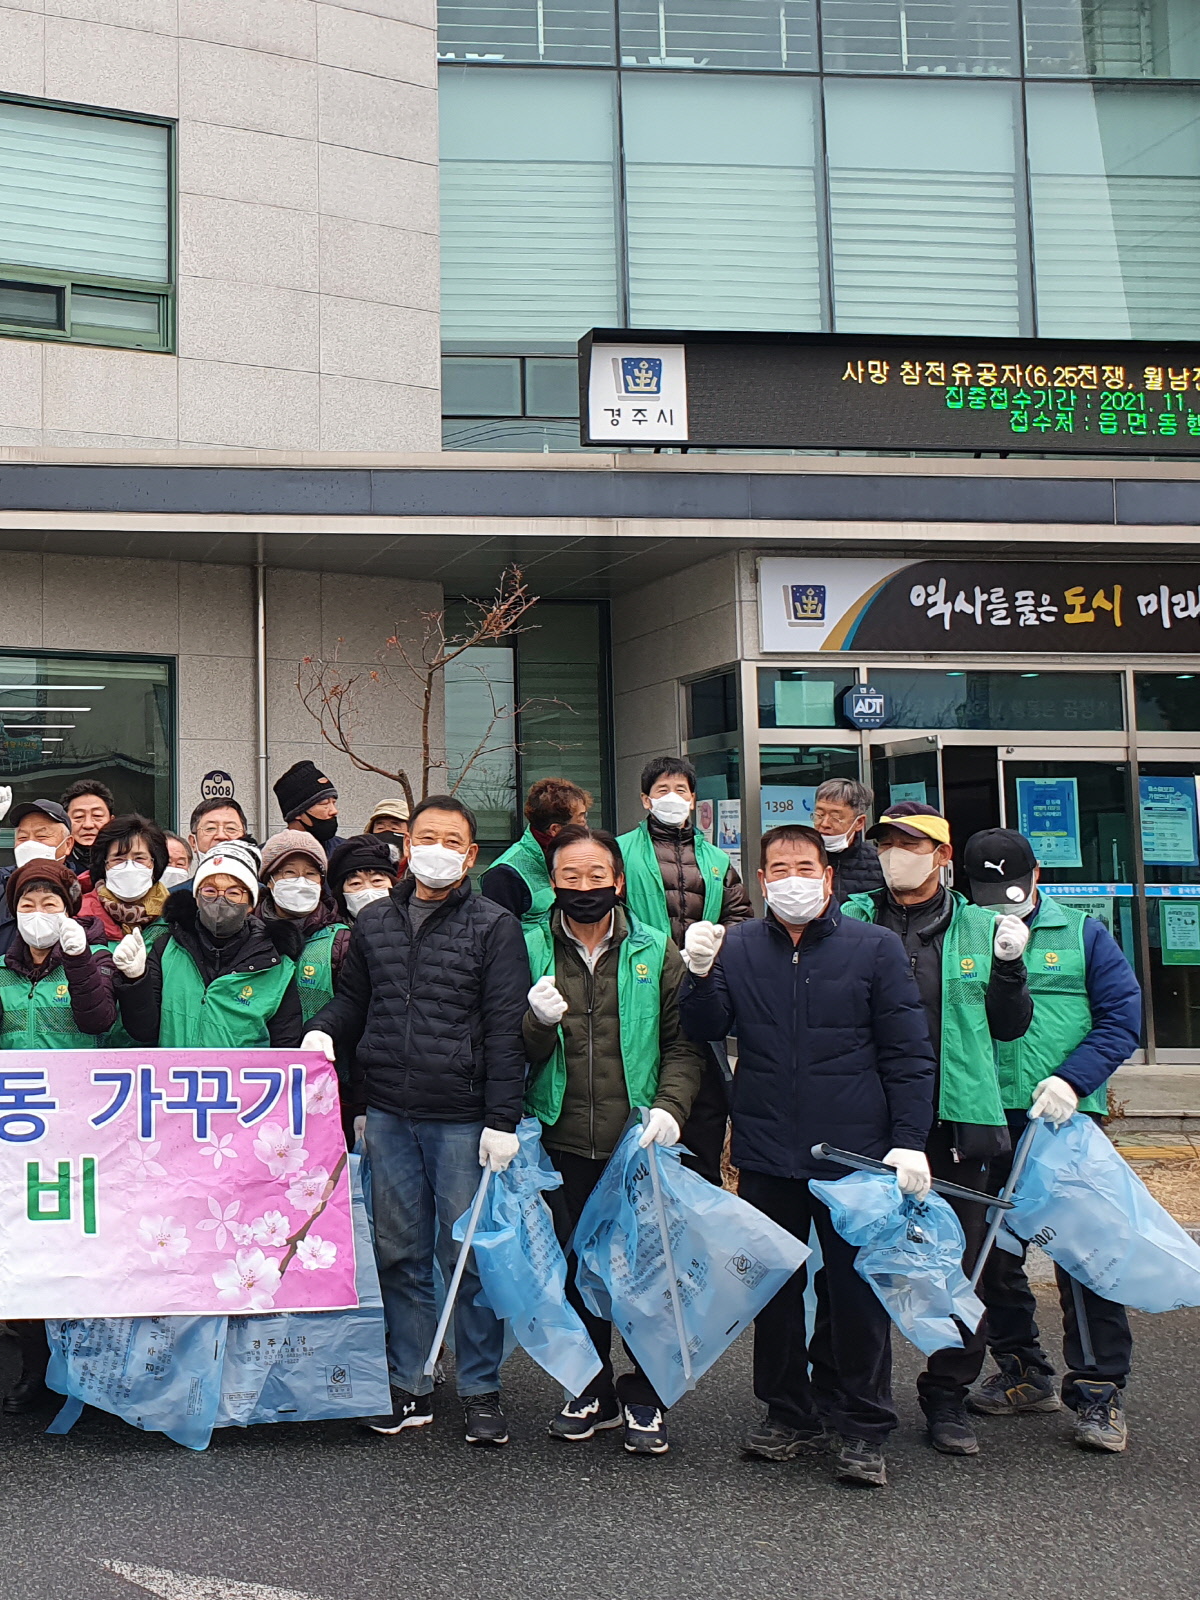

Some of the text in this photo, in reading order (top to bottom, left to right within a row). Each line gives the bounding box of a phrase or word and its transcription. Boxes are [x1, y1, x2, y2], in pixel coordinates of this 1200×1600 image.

[842, 361, 889, 384] 사망
[944, 386, 1077, 412] 집중접수기간
[603, 408, 674, 427] 경주시
[1009, 410, 1075, 434] 접수처
[1098, 412, 1178, 436] 읍.면.동
[909, 577, 1011, 630] 역사를
[1014, 590, 1058, 627] 품은
[1063, 584, 1123, 627] 도시
[854, 698, 884, 714] ADT
[205, 785, 231, 796] 3008
[765, 800, 794, 813] 1398
[91, 1067, 304, 1139] 가꾸기
